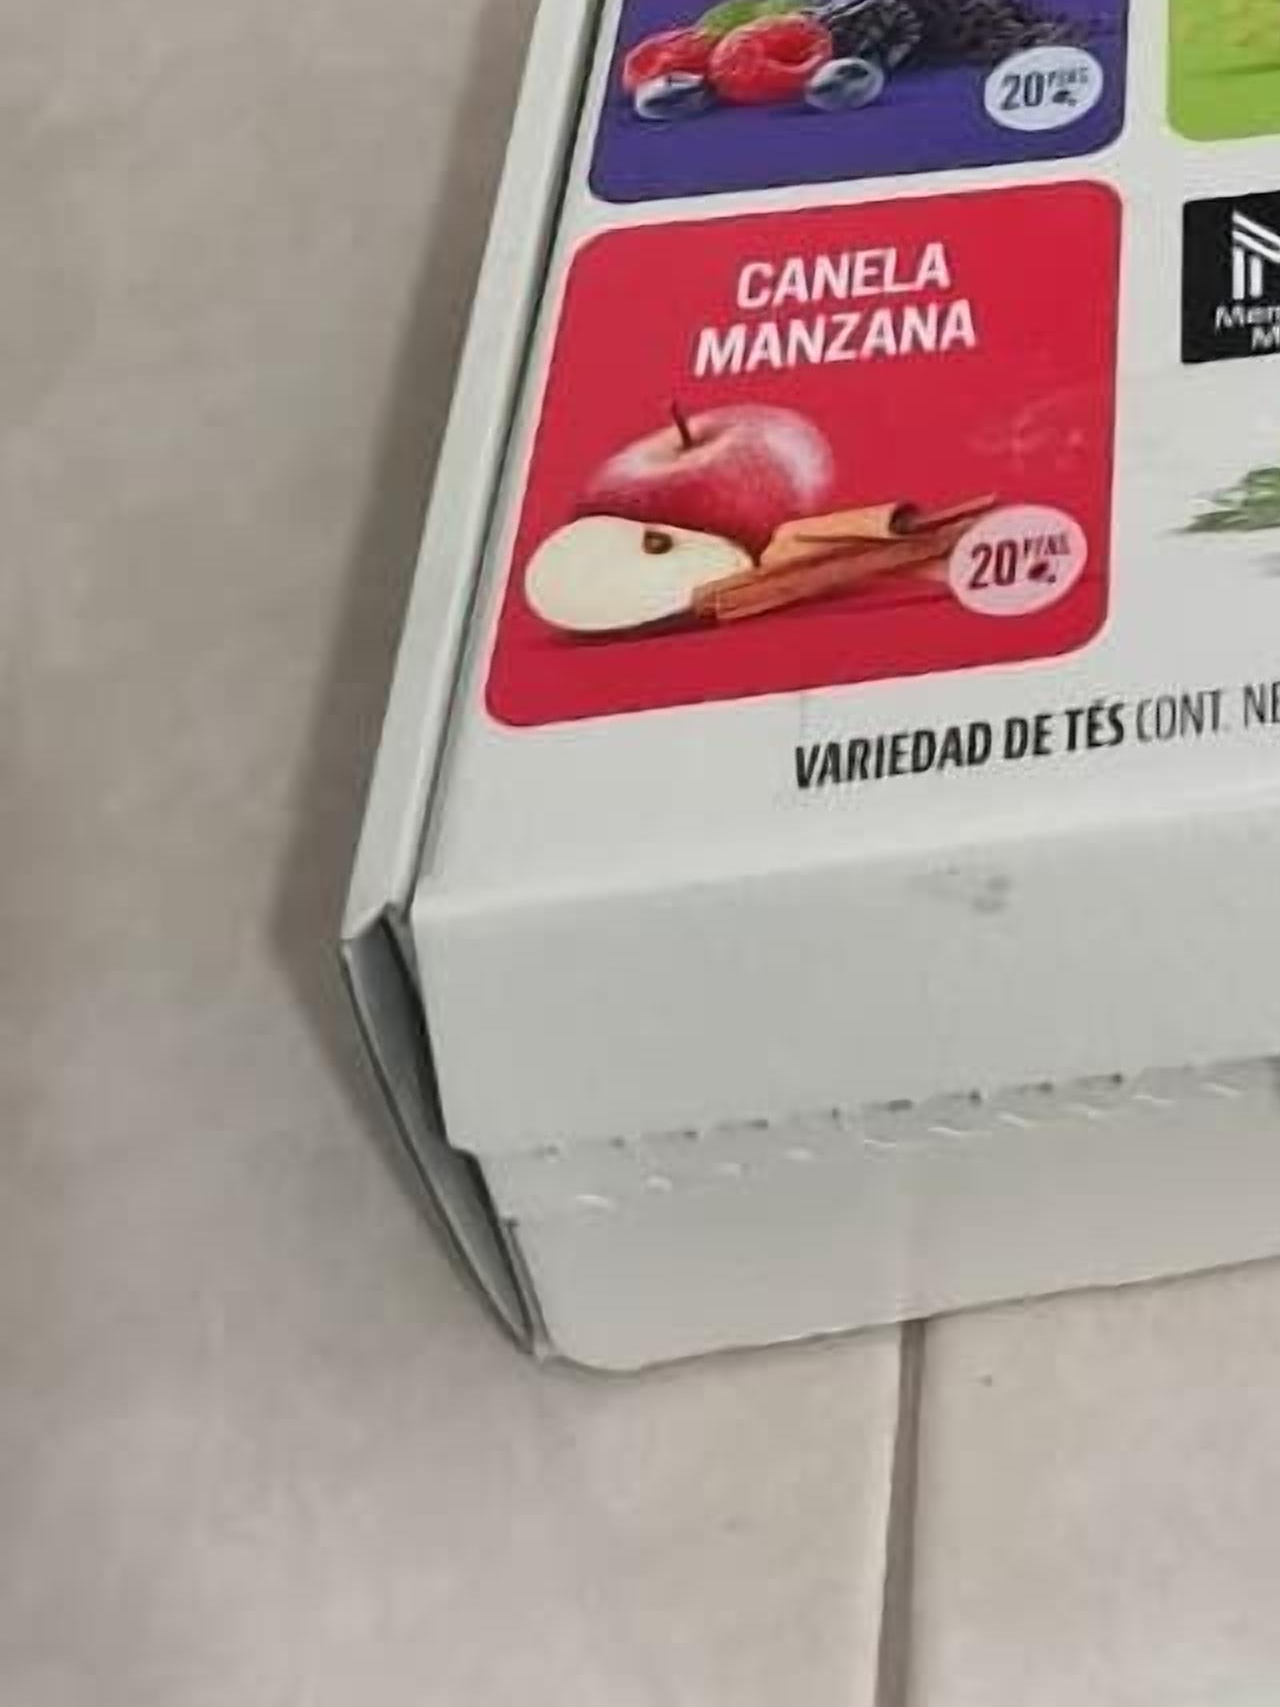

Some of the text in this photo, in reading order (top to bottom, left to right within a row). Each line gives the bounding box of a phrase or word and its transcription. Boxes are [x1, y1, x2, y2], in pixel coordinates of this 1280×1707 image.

[1000, 71, 1045, 111] 20
[735, 242, 952, 310] CANELA
[693, 299, 977, 377] MANZANA
[967, 537, 1020, 591] 20
[795, 720, 992, 789] VARIEDAD
[1003, 709, 1054, 760] DE
